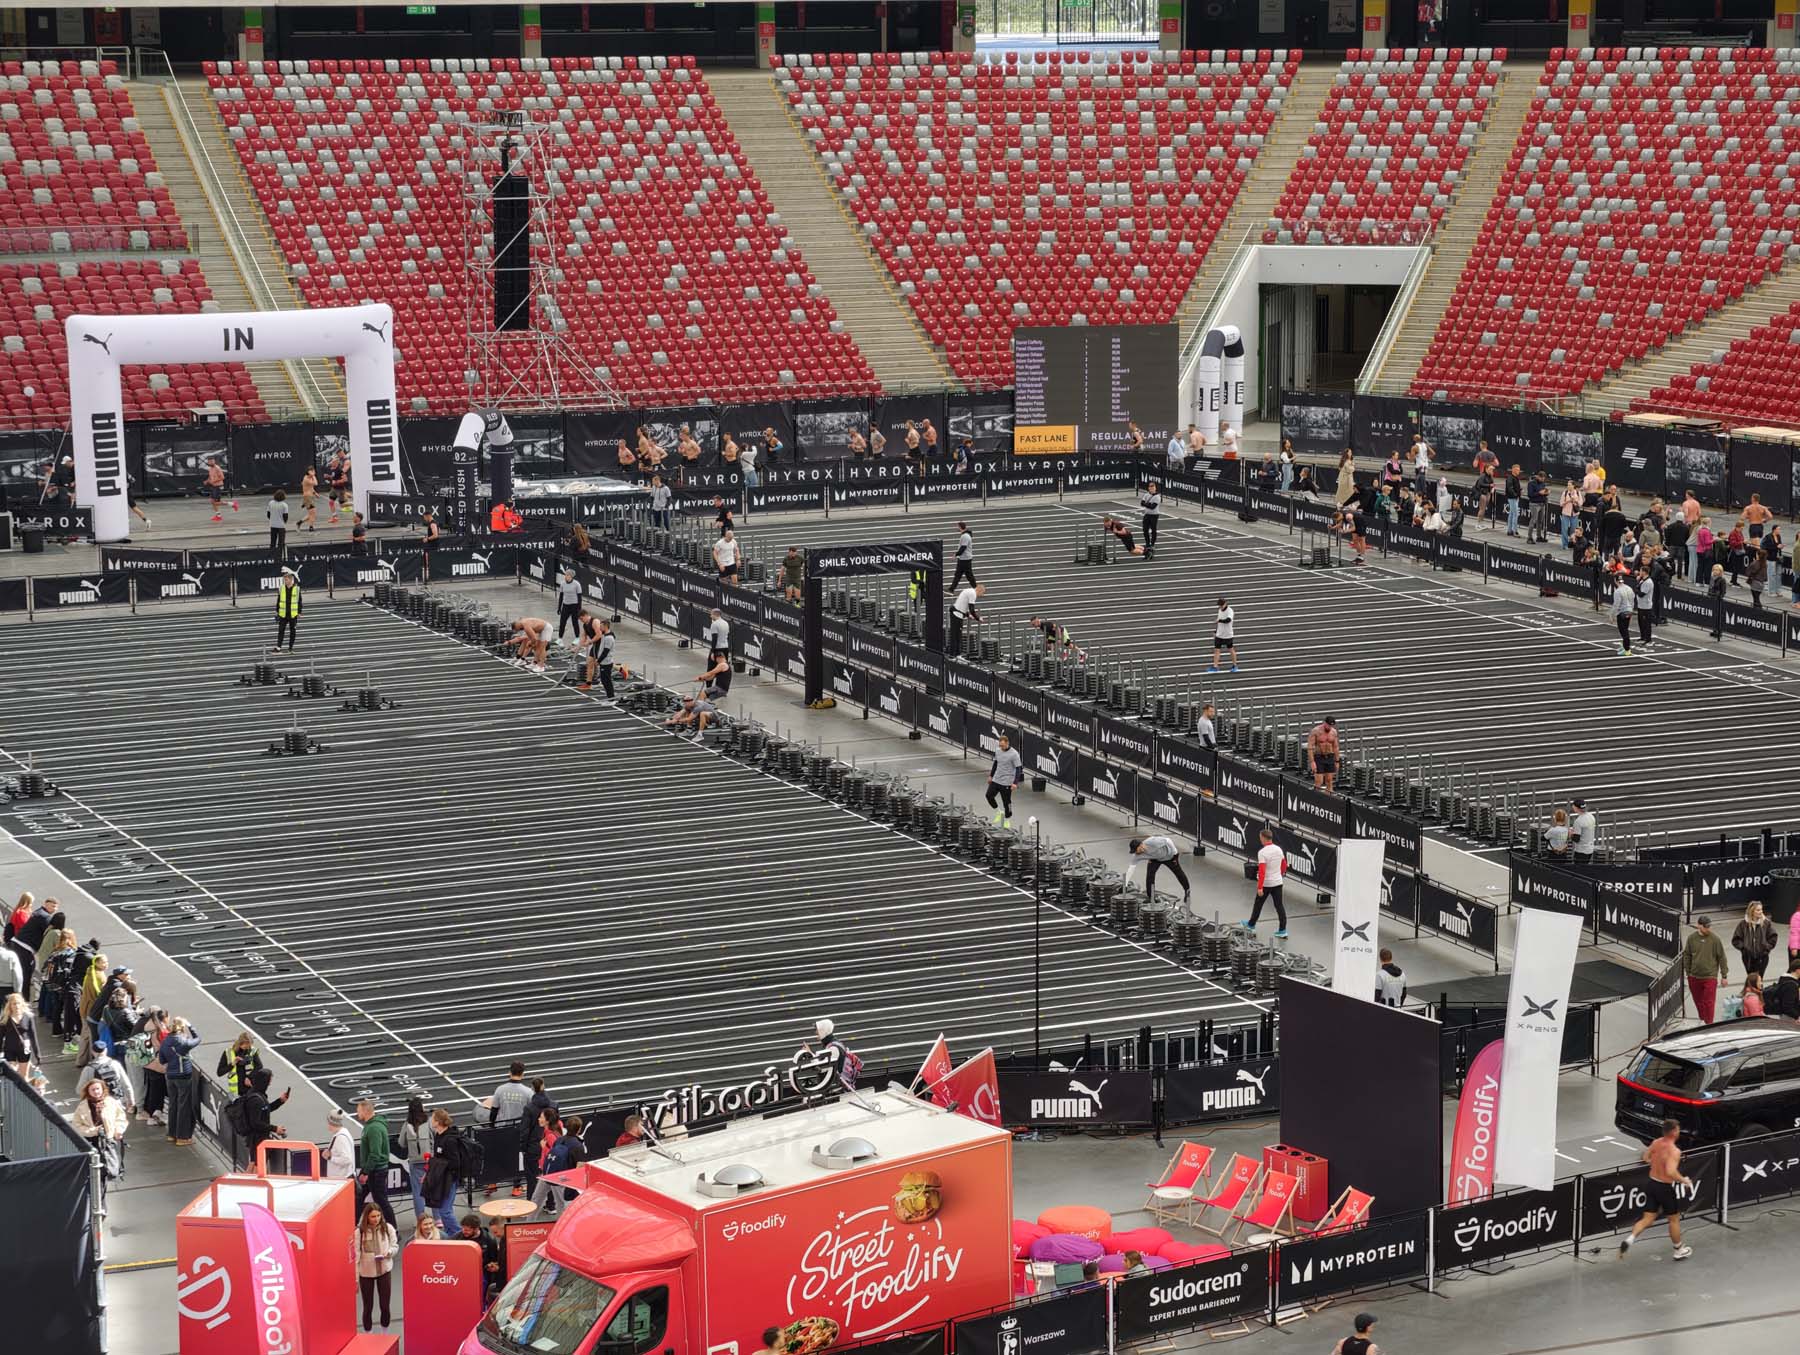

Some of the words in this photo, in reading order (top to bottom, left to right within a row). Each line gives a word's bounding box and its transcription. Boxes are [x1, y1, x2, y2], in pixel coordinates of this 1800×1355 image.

[223, 327, 254, 351] IN
[1371, 421, 1404, 431] HYROX
[367, 399, 396, 482] PUMA
[1020, 435, 1042, 443] FAST
[1045, 434, 1068, 442] LANE
[1091, 431, 1131, 440] REGULA
[1496, 434, 1531, 448] HYROX
[91, 412, 121, 497] PUMA
[254, 451, 292, 459] #HYROX
[769, 469, 832, 482] HYROX
[850, 465, 914, 478] HYROX
[931, 462, 996, 475] HYOX
[1744, 470, 1779, 481] HYROX.COM
[689, 473, 738, 485] HYRO
[1005, 477, 1054, 488] MYPROTEIN
[1082, 472, 1130, 483] MYPROTEIN
[849, 487, 898, 497] MYPROTEIN
[928, 482, 977, 492] MYPROTEIN
[768, 493, 819, 503] MYPROTEIN
[376, 503, 440, 516] HYROX
[1398, 535, 1430, 549] MYPROTEIN
[819, 557, 848, 569] SMILE,
[850, 554, 881, 566] YOU'RE
[883, 554, 895, 563] ON
[897, 551, 934, 562] CAMERA
[1448, 547, 1481, 562] MYPROTEIN
[123, 560, 177, 570] MYPROTEIN
[452, 562, 485, 575] PUMA
[1501, 560, 1536, 575] MYPROTEIN
[357, 569, 391, 583] PUMA
[1555, 573, 1591, 588] MYPROTEIN
[59, 590, 95, 604] PUMA
[161, 583, 196, 597] PUMA
[1673, 601, 1713, 617] MYPROTEIN
[1736, 616, 1778, 632] MYPROTEIN
[860, 643, 890, 660] MYPROTEIN
[908, 660, 939, 677] MYPROTEIN
[957, 676, 989, 694] MYPROTEIN
[880, 694, 899, 714] PUMA
[1006, 694, 1038, 713] MYPROTEIN
[928, 713, 949, 734] PUMA
[1056, 715, 1090, 734] MYPROTEIN
[1111, 733, 1149, 754] MYPROTEIN
[1036, 755, 1059, 777] PUMA
[1172, 755, 1210, 776] MYPROTEIN
[1092, 776, 1116, 799] PUMA
[1233, 777, 1274, 800] MYPROTEIN
[1153, 800, 1178, 824] PUMA
[1299, 801, 1342, 824] MYPROTEIN
[1218, 825, 1244, 849] PUMA
[1368, 827, 1415, 851] MYPROTEIN
[1533, 882, 1587, 910] MYPROTEIN
[1439, 910, 1468, 936] PUMA
[1620, 912, 1673, 942] MYPROTEIN
[1516, 1023, 1558, 1032] XPENG
[1203, 1087, 1257, 1111] PUMA
[1031, 1098, 1092, 1118] PUMA
[1464, 1074, 1499, 1172] foodify
[522, 1228, 548, 1237] foodify
[741, 1214, 787, 1236] foodify
[1484, 1207, 1557, 1242] foodify
[801, 1219, 895, 1300] Street
[1320, 1240, 1415, 1274] MYPROTEIN
[422, 1273, 459, 1287] foodify
[836, 1243, 963, 1327] Foodify
[1149, 1310, 1176, 1323] EXPERT
[1177, 1305, 1198, 1316] KREM
[1199, 1294, 1241, 1311] BARIEROWY
[1024, 1327, 1066, 1345] Warszawa
